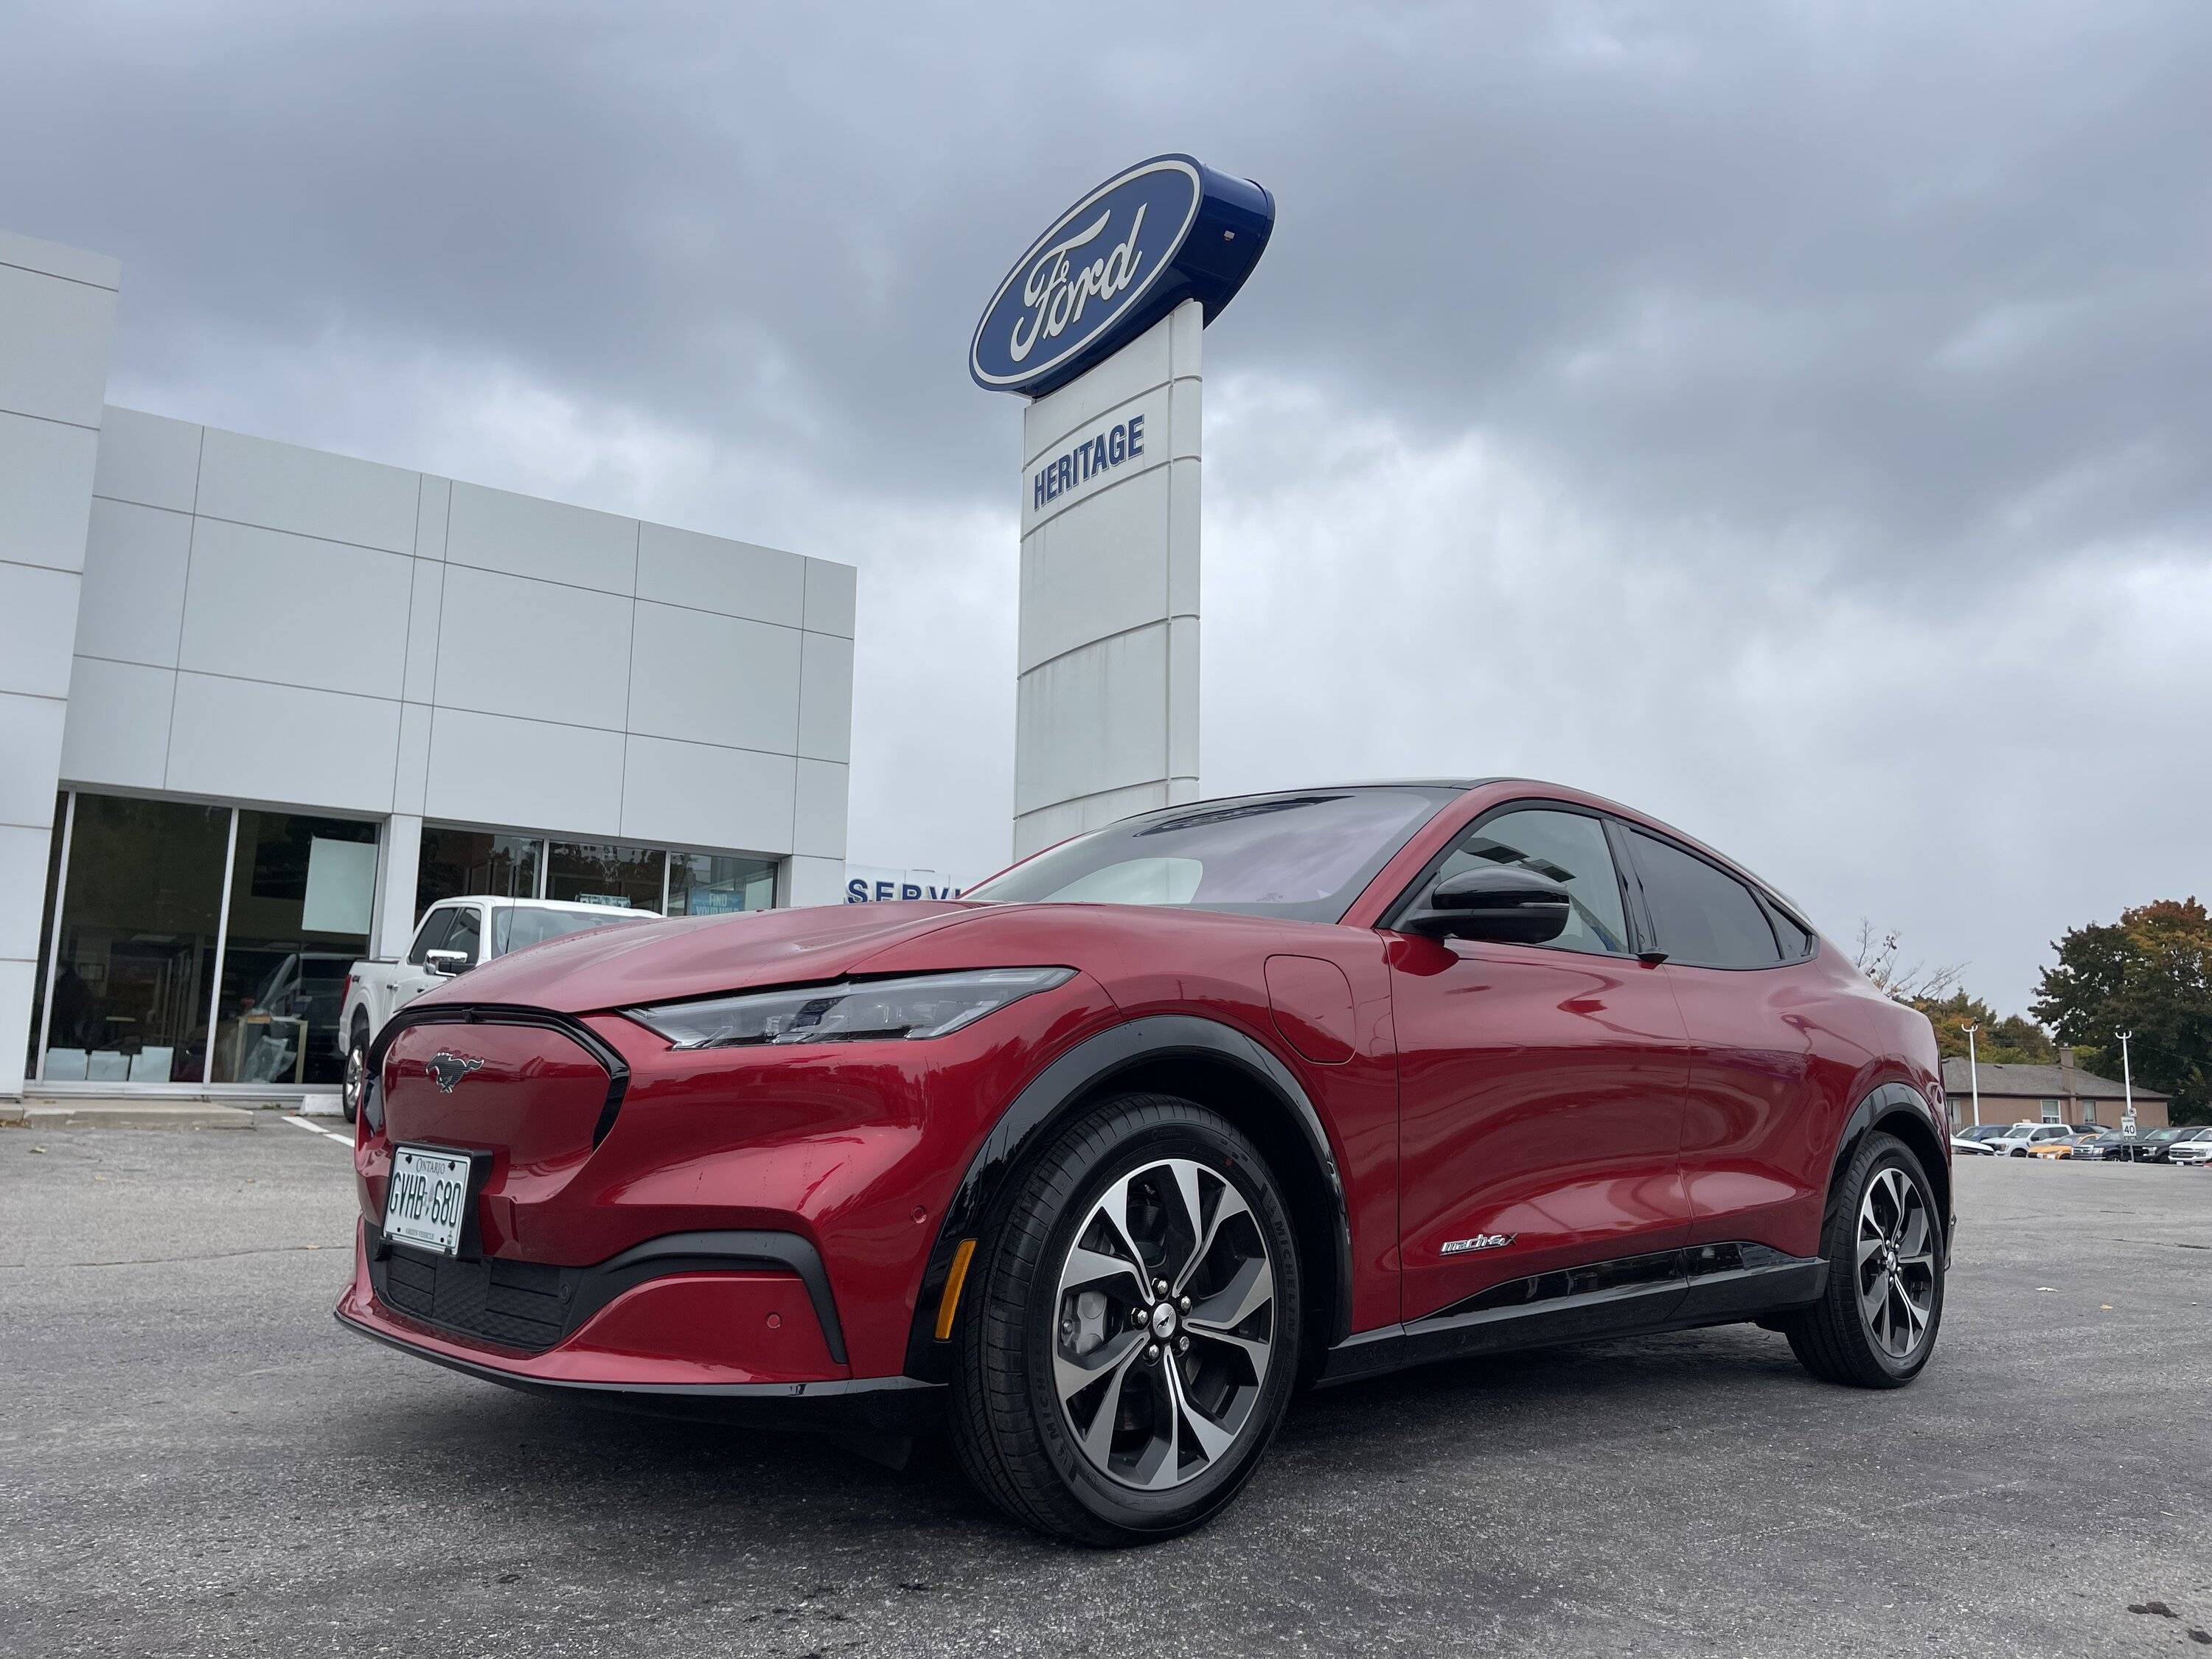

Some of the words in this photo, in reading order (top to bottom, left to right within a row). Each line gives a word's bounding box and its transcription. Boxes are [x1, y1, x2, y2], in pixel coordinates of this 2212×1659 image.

[1010, 202, 1147, 362] Ford
[1034, 413, 1145, 512] HERITAGE
[709, 893, 727, 907] FIND
[2124, 1125, 2135, 1134] 40
[417, 1158, 445, 1175] ONTARIO
[431, 1179, 461, 1227] 680
